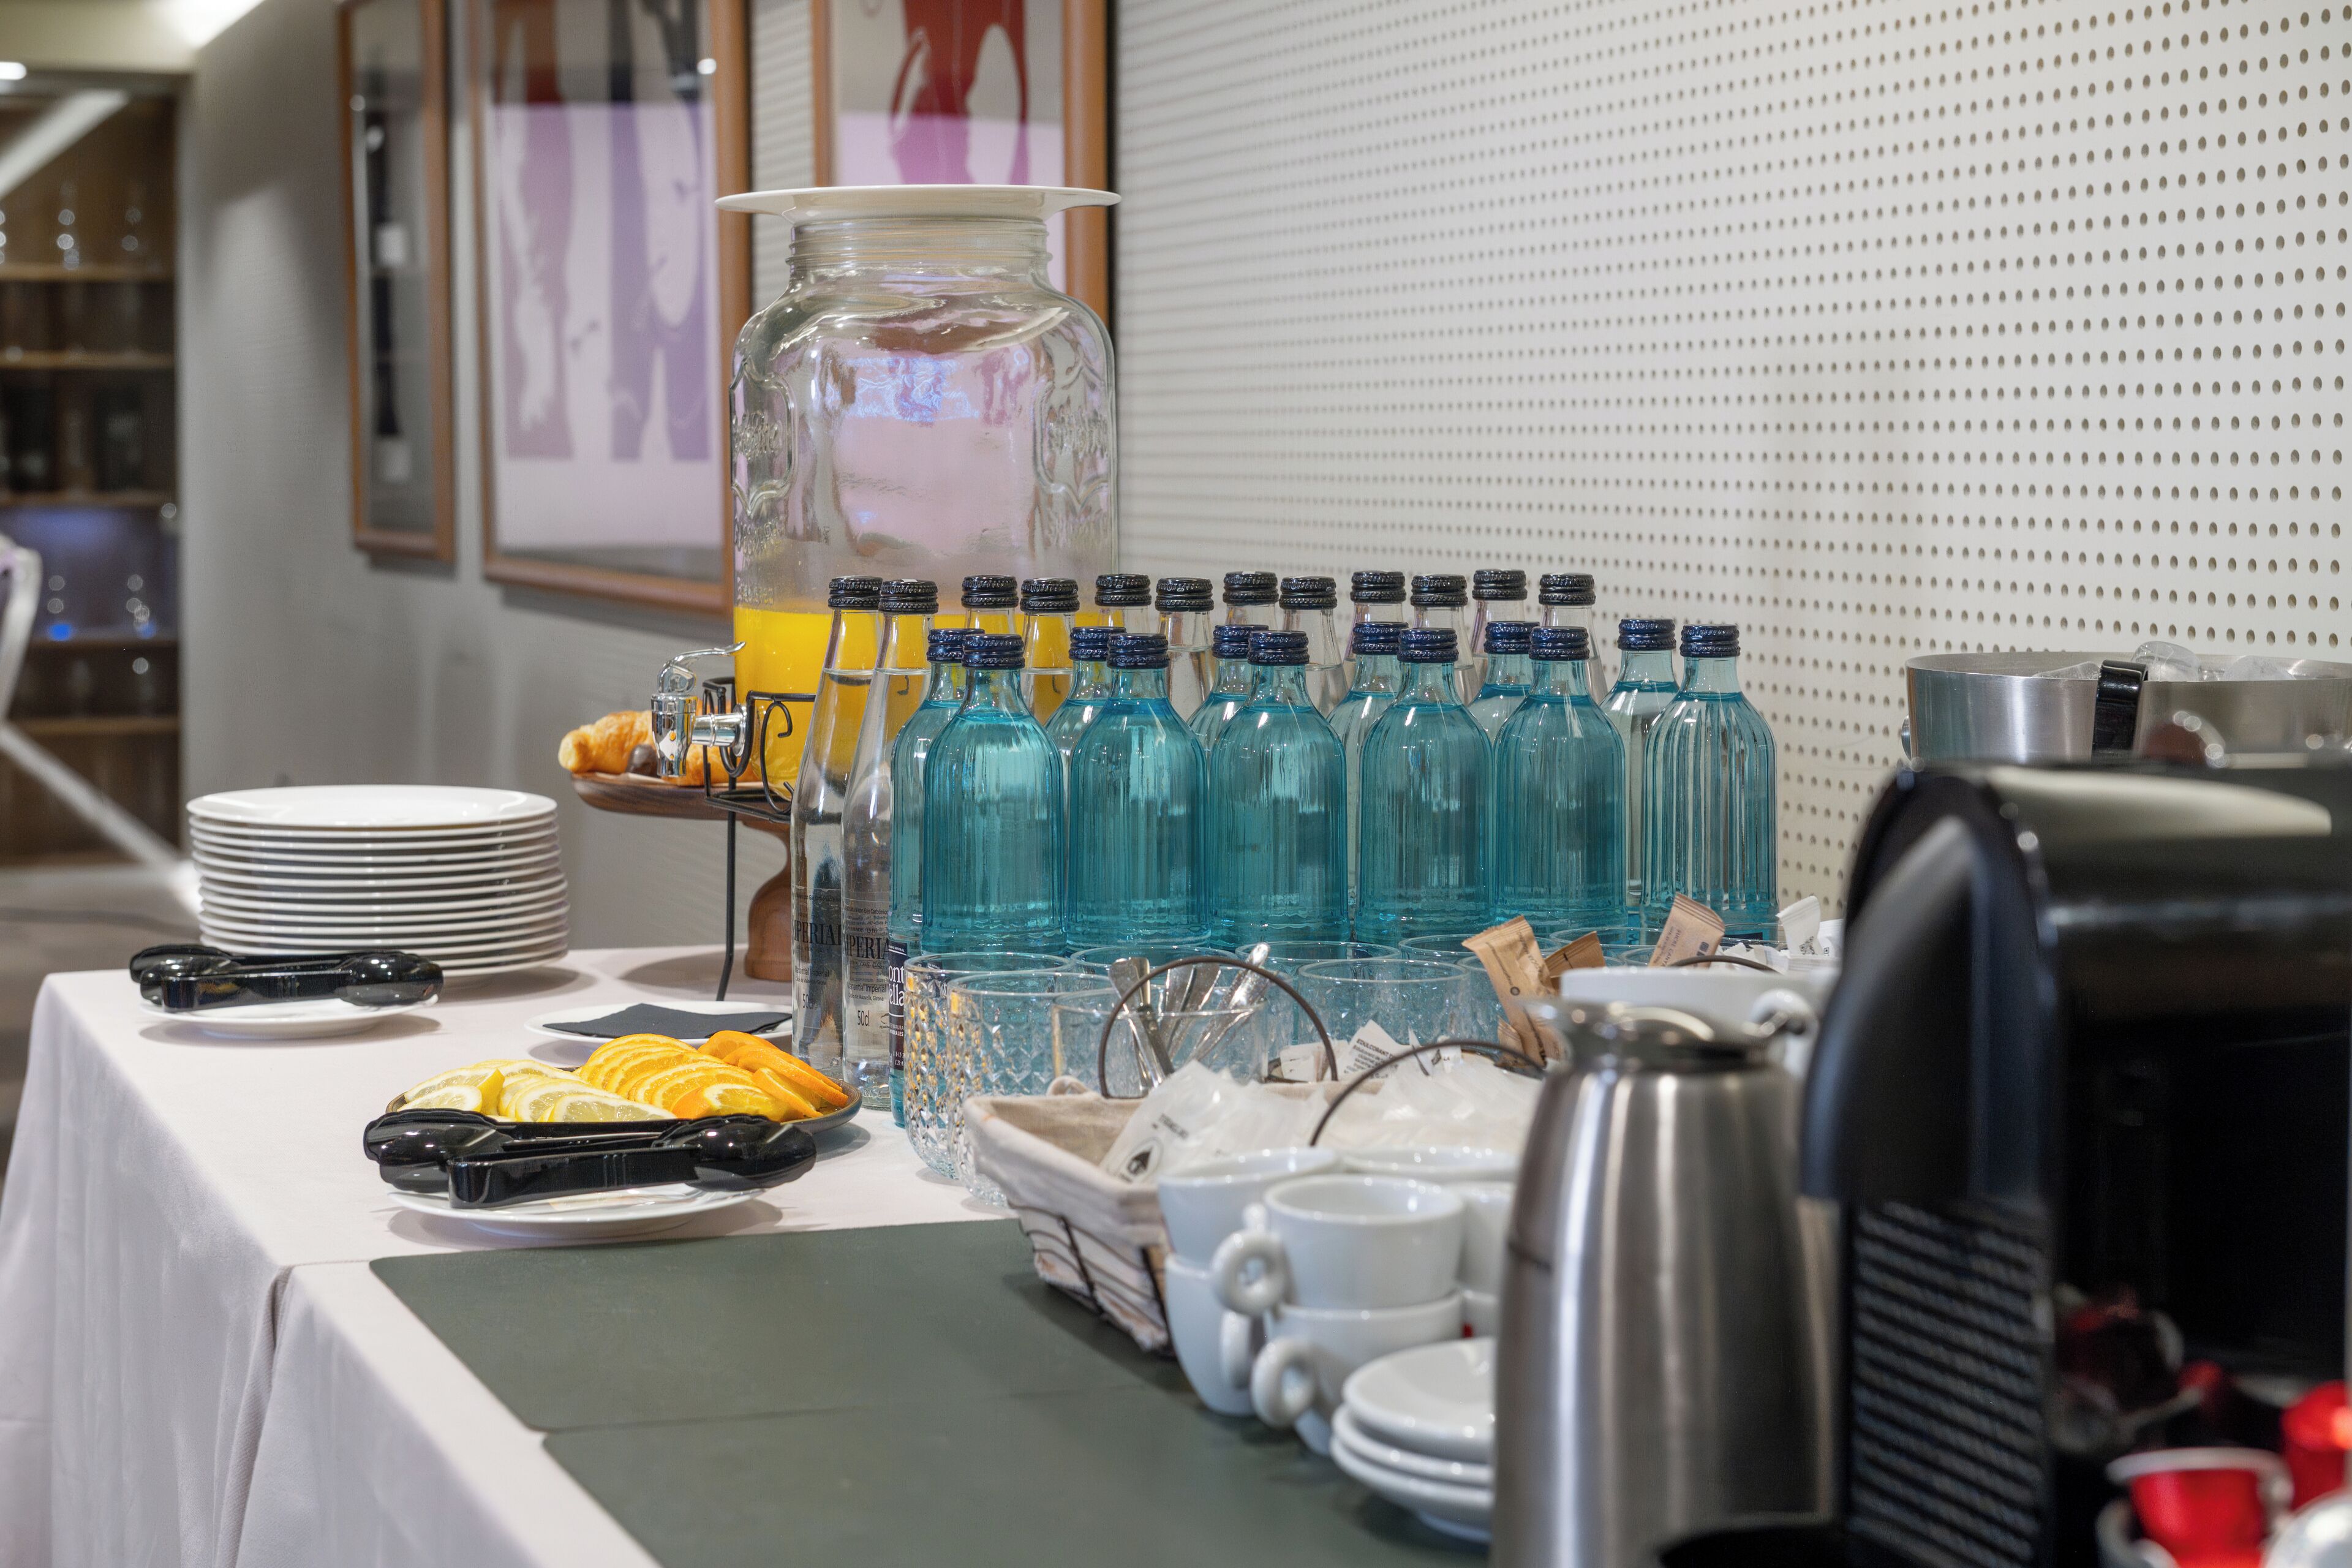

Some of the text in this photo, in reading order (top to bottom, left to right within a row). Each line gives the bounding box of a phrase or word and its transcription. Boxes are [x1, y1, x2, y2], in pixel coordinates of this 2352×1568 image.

[889, 965, 905, 984] ont
[865, 984, 887, 994] Imperial
[889, 983, 905, 1006] ella
[858, 1010, 870, 1027] 50cl
